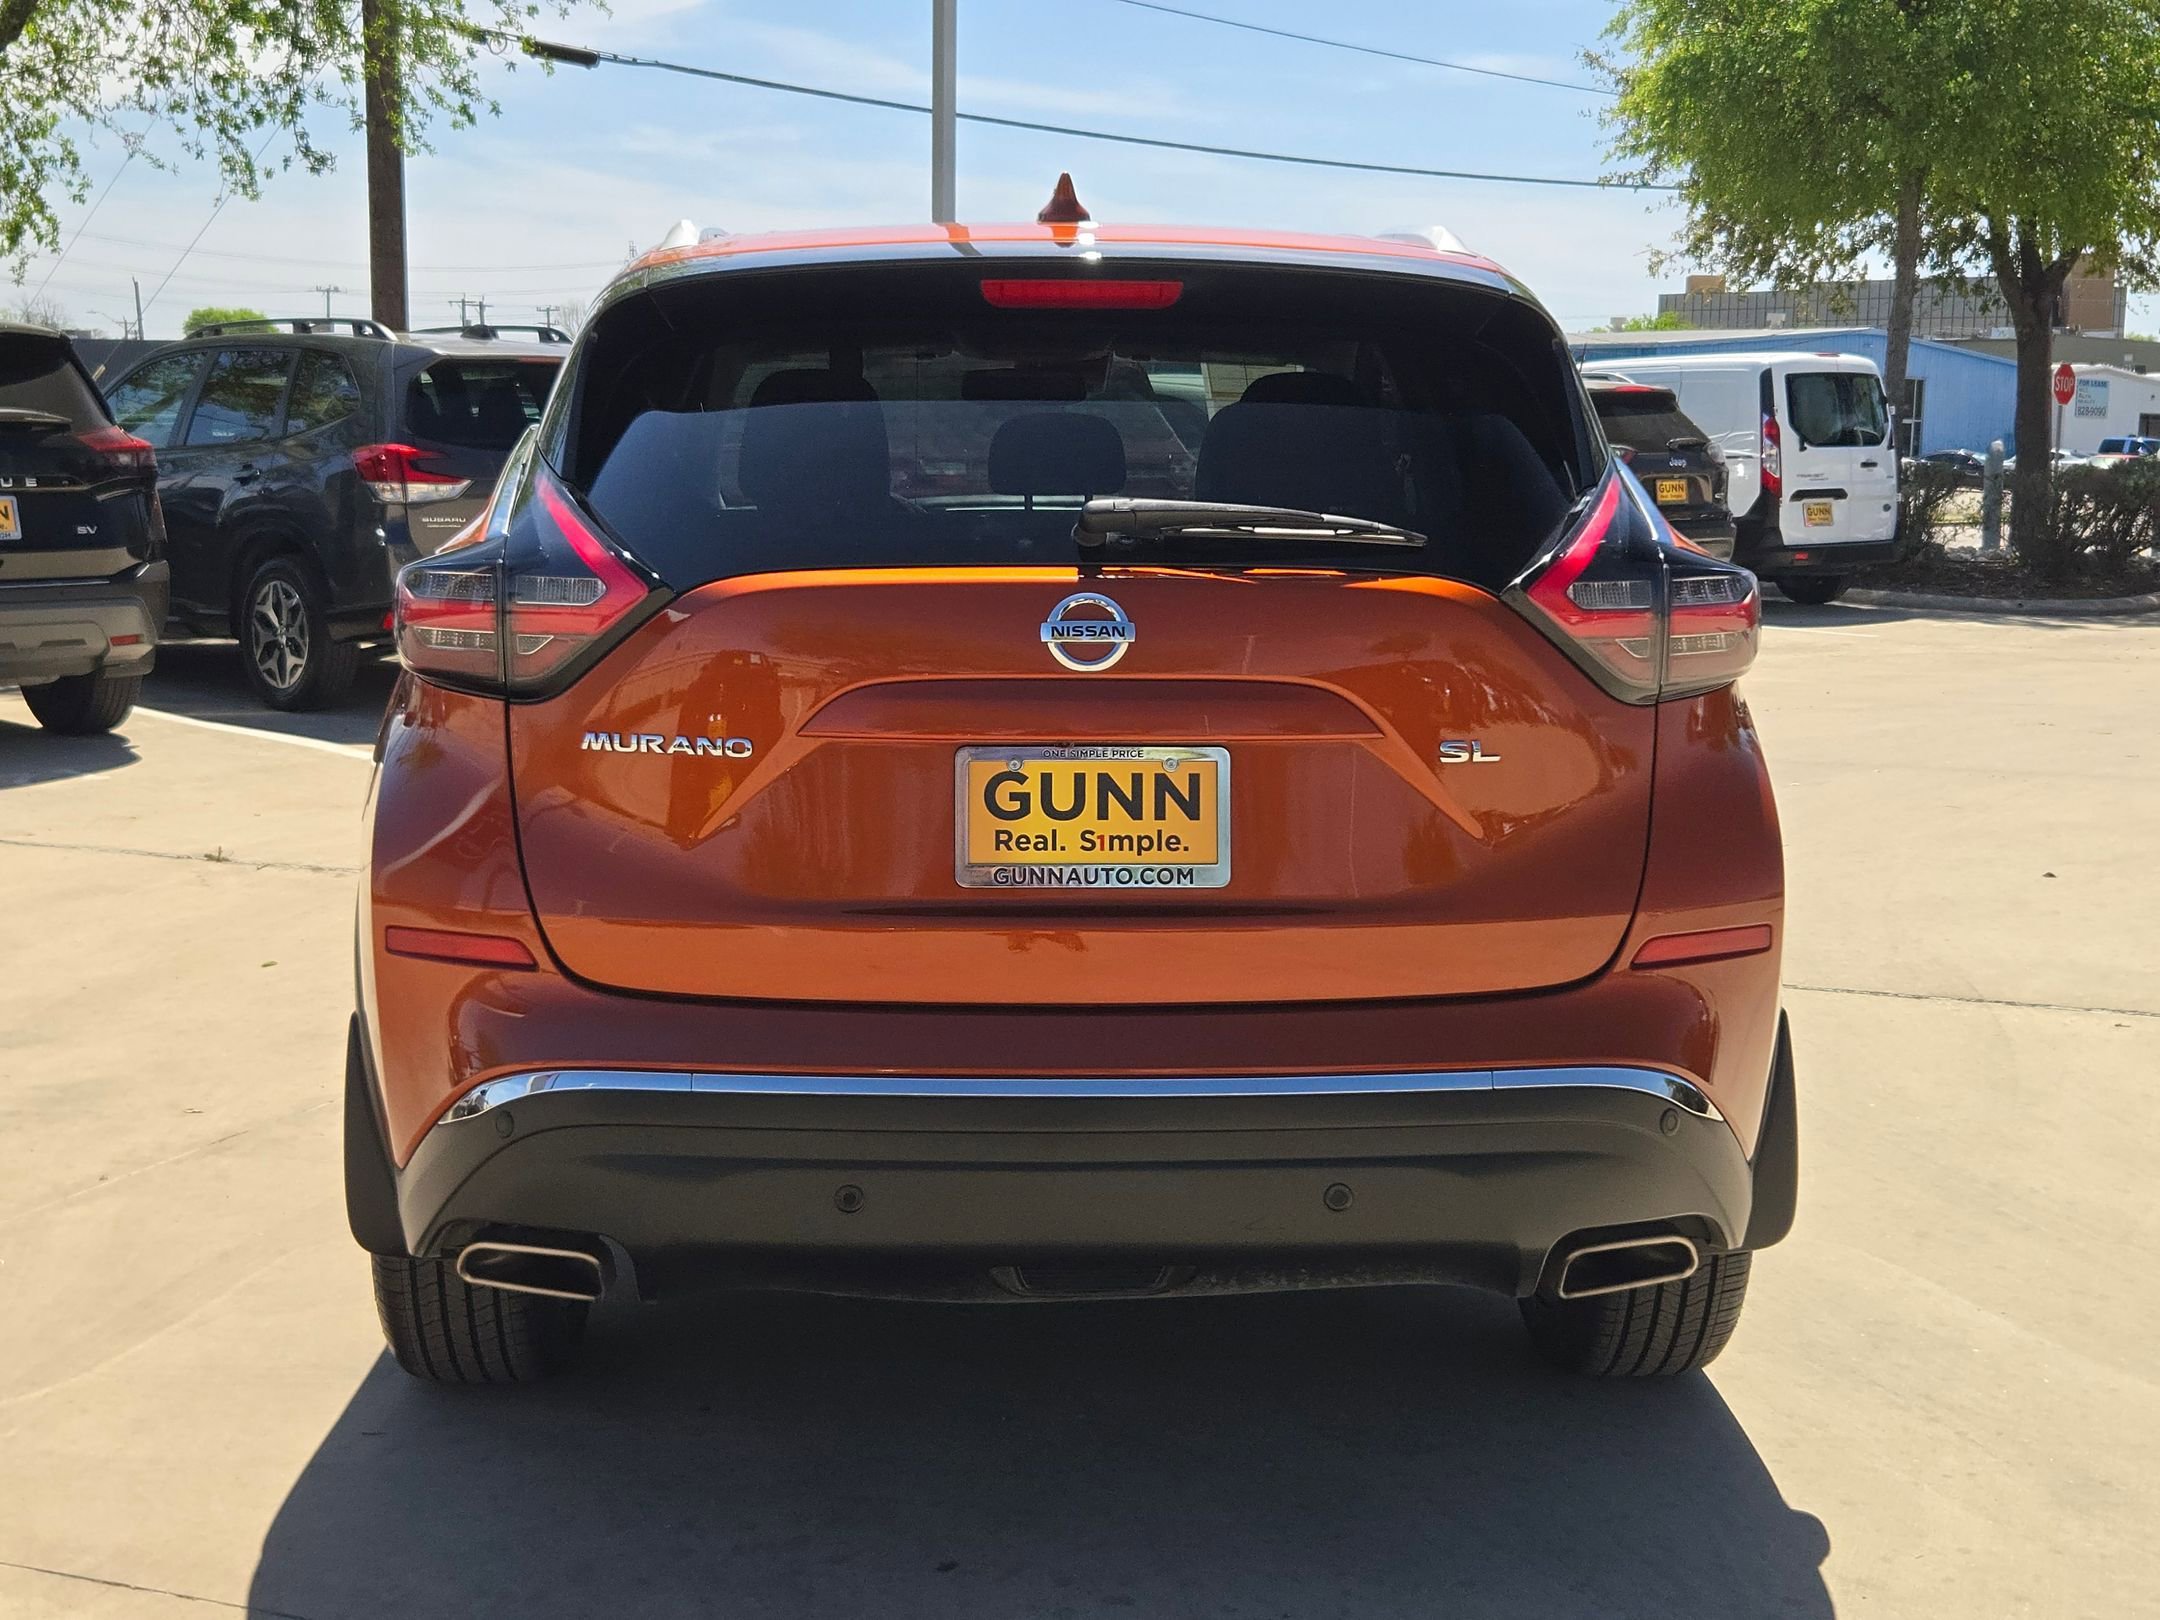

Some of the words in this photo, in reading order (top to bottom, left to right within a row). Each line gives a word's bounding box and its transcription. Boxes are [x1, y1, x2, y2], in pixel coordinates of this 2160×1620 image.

[2055, 376, 2074, 392] STOP
[2079, 379, 2090, 387] FOR
[2091, 380, 2108, 388] LEASE
[1669, 457, 1687, 468] Jeep
[1659, 483, 1685, 494] GUNN
[1806, 507, 1831, 517] GUNN
[77, 526, 98, 534] SV
[1050, 625, 1126, 638] NISSAN
[580, 731, 753, 758] MURANO
[1042, 749, 1066, 759] ONE
[1070, 749, 1109, 759] SIMPLE
[1112, 749, 1145, 759] PRICE
[1439, 740, 1502, 763] SL
[983, 770, 1201, 822] GUNN
[994, 829, 1066, 852] Real.
[993, 867, 1195, 886] GUNNAUTO.COM
